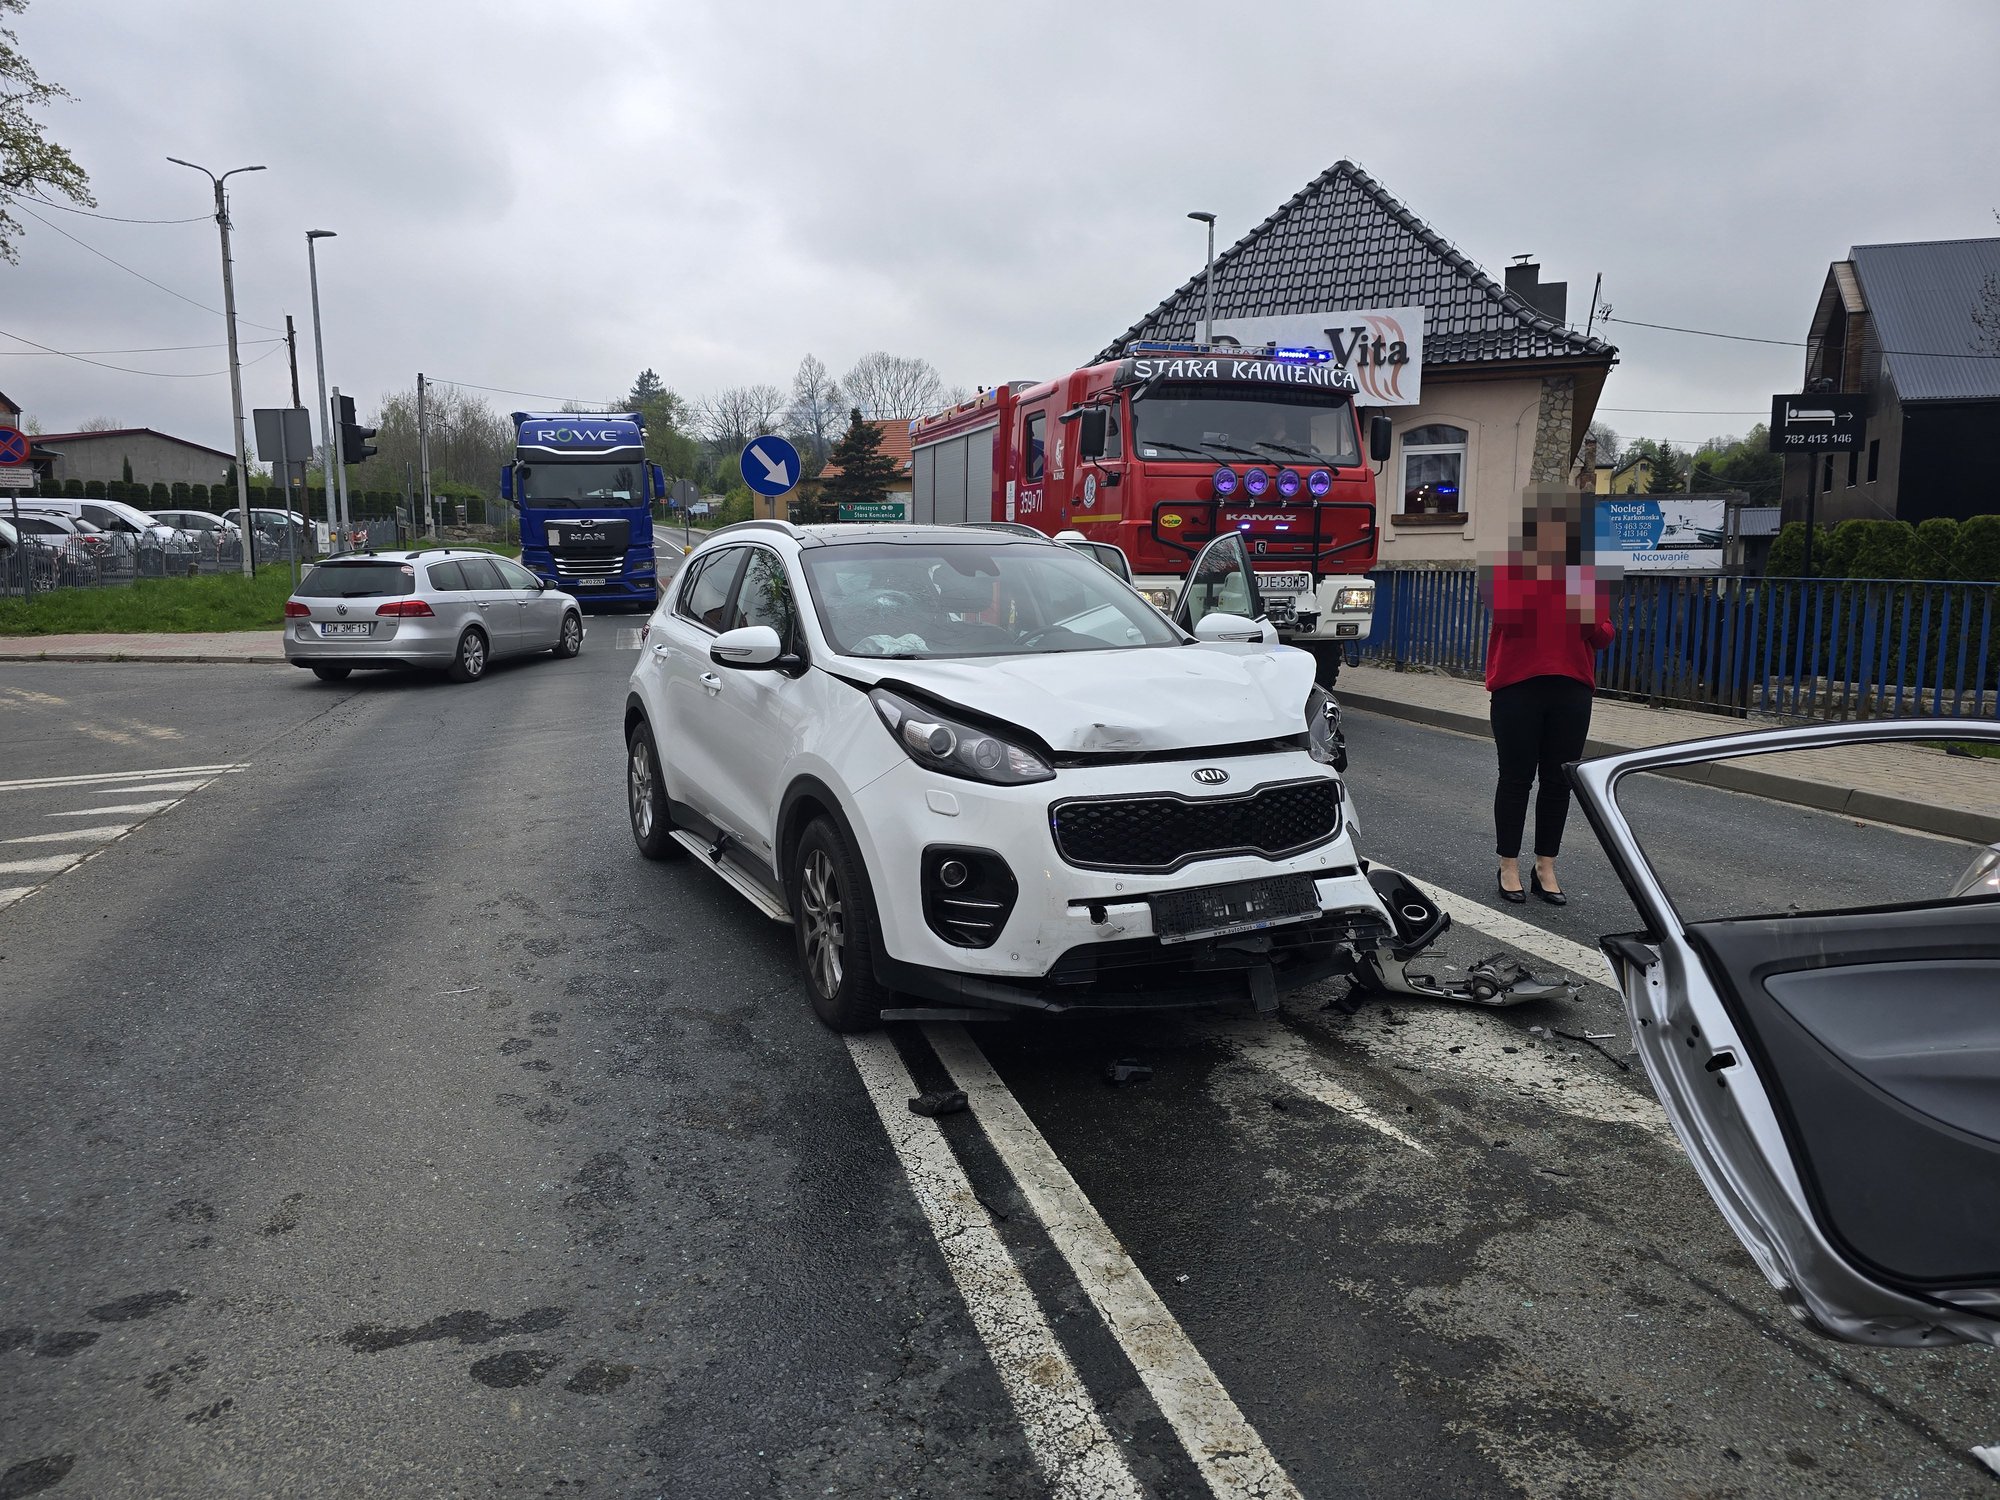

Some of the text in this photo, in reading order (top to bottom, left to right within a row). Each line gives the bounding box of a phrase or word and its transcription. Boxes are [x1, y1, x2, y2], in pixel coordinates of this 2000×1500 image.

[1324, 326, 1410, 370] Vita
[1134, 360, 1357, 390] STARA KAMIENICA
[537, 428, 618, 443] ROWE
[1784, 434, 1852, 444] 782 413 146
[1610, 504, 1645, 515] Noclegi
[570, 533, 606, 541] MAN
[1632, 552, 1689, 562] Nocowanie
[1257, 576, 1306, 588] DJE 53W5
[327, 623, 338, 633] DW
[1196, 769, 1227, 781] KIA
